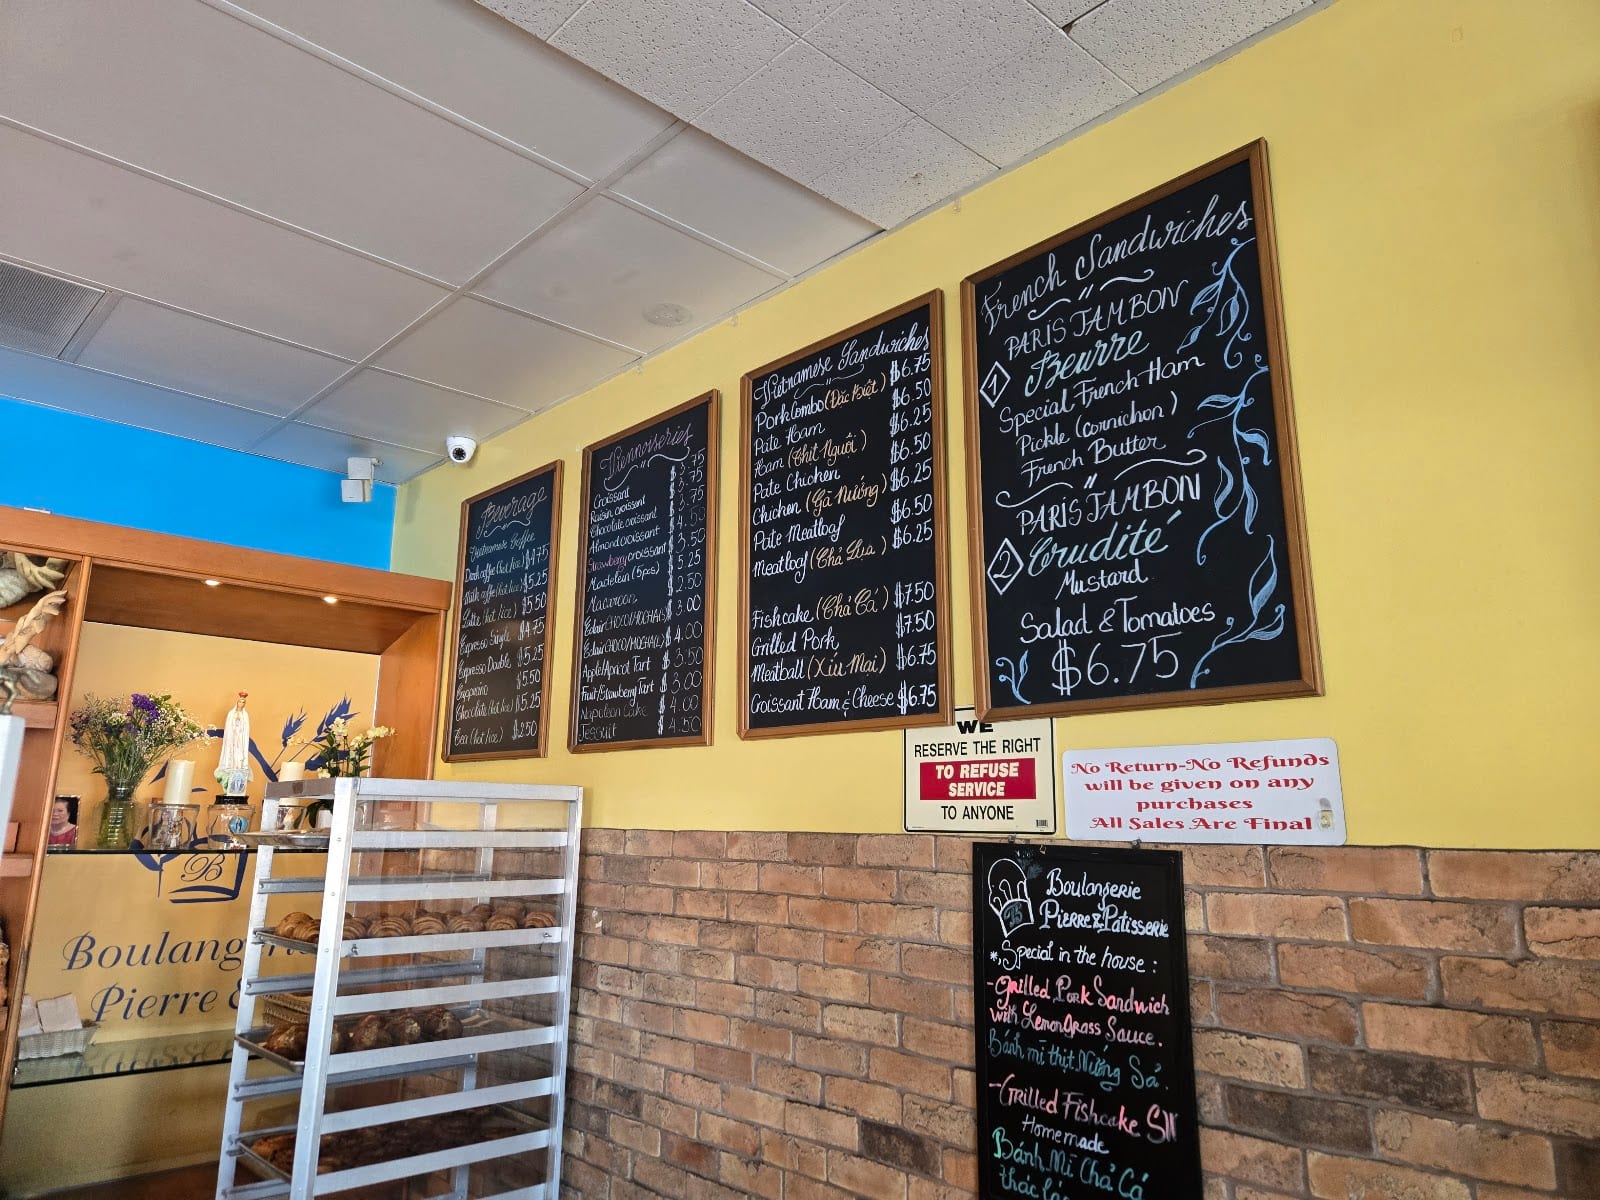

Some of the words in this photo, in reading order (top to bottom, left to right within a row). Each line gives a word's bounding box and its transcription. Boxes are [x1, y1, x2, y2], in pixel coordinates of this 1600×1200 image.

[982, 252, 1066, 335] French
[1074, 194, 1253, 280] Sandwiches
[838, 322, 930, 371] Sandwiches
[1004, 318, 1066, 360] PARIS
[890, 352, 930, 386] $6.75
[1024, 330, 1150, 398] Beurre
[787, 422, 825, 446] Ham
[892, 378, 931, 410] $6.50
[1000, 389, 1076, 436] Special
[1073, 370, 1140, 409] French
[1137, 354, 1206, 385] Ham
[754, 458, 784, 478] Ham
[890, 402, 931, 436] $6.25
[1016, 425, 1070, 456] Pickle
[786, 466, 840, 492] Chicken
[890, 432, 931, 464] $6.50
[1020, 456, 1084, 488] French
[1086, 434, 1167, 464] Butter
[594, 486, 630, 509] Croissant
[615, 494, 646, 516] croissant
[752, 500, 801, 526] Chicken
[890, 457, 932, 491] $6.25
[626, 506, 657, 527] croissant
[786, 514, 846, 542] Meatloaf
[891, 493, 932, 524] $6.50
[892, 519, 932, 548] $6.25
[1016, 496, 1082, 536] PARIS
[589, 536, 619, 554] Almond
[620, 525, 660, 546] croissant
[628, 542, 666, 560] croissant
[1055, 558, 1148, 600] Mustard
[752, 604, 814, 630] Fishcake
[894, 581, 934, 608] $7.50
[1020, 603, 1092, 644] Salad
[1099, 608, 1114, 632] &
[1114, 596, 1216, 633] Tomatoes
[752, 631, 796, 656] Grilled
[802, 626, 839, 650] Pork
[896, 610, 934, 638] $7.50
[632, 656, 651, 672] Tart
[752, 658, 806, 682] Meatball
[896, 642, 936, 670] $6.75
[1052, 632, 1182, 696] $6.75
[638, 677, 655, 694] Tart
[751, 692, 804, 714] Croissant
[804, 686, 840, 710] Ham
[852, 684, 894, 708] Cheese
[897, 680, 936, 715] $6.75
[954, 720, 994, 734] WE
[914, 742, 968, 758] RESERVE
[973, 740, 996, 754] THE
[1002, 738, 1040, 753] RIGHT
[1071, 762, 1100, 775] No
[1226, 754, 1330, 772] Refunds
[936, 764, 954, 780] TO
[960, 762, 1019, 778] REFUSE
[948, 782, 1006, 798] SERVICE
[1084, 779, 1122, 792] will
[1129, 778, 1154, 791] be
[1160, 778, 1222, 794] given
[1229, 779, 1260, 790] on
[1268, 778, 1314, 791] any
[941, 806, 956, 820] TO
[962, 806, 1014, 820] ANYONE
[1089, 817, 1122, 830] All
[1128, 818, 1185, 830] Sales
[1189, 818, 1236, 831] Are
[1243, 817, 1312, 831] Final
[1136, 798, 1254, 812] purchases
[180, 852, 224, 881] B
[1046, 868, 1142, 910] Boulangerie
[1059, 947, 1070, 962] in
[1074, 945, 1096, 966] the
[90, 982, 218, 1022] Pierre
[1052, 974, 1094, 1006] Pork
[1094, 974, 1170, 1014] Sandwich
[1022, 1113, 1109, 1154] Homemade
[1062, 1092, 1140, 1136] Fishcake
